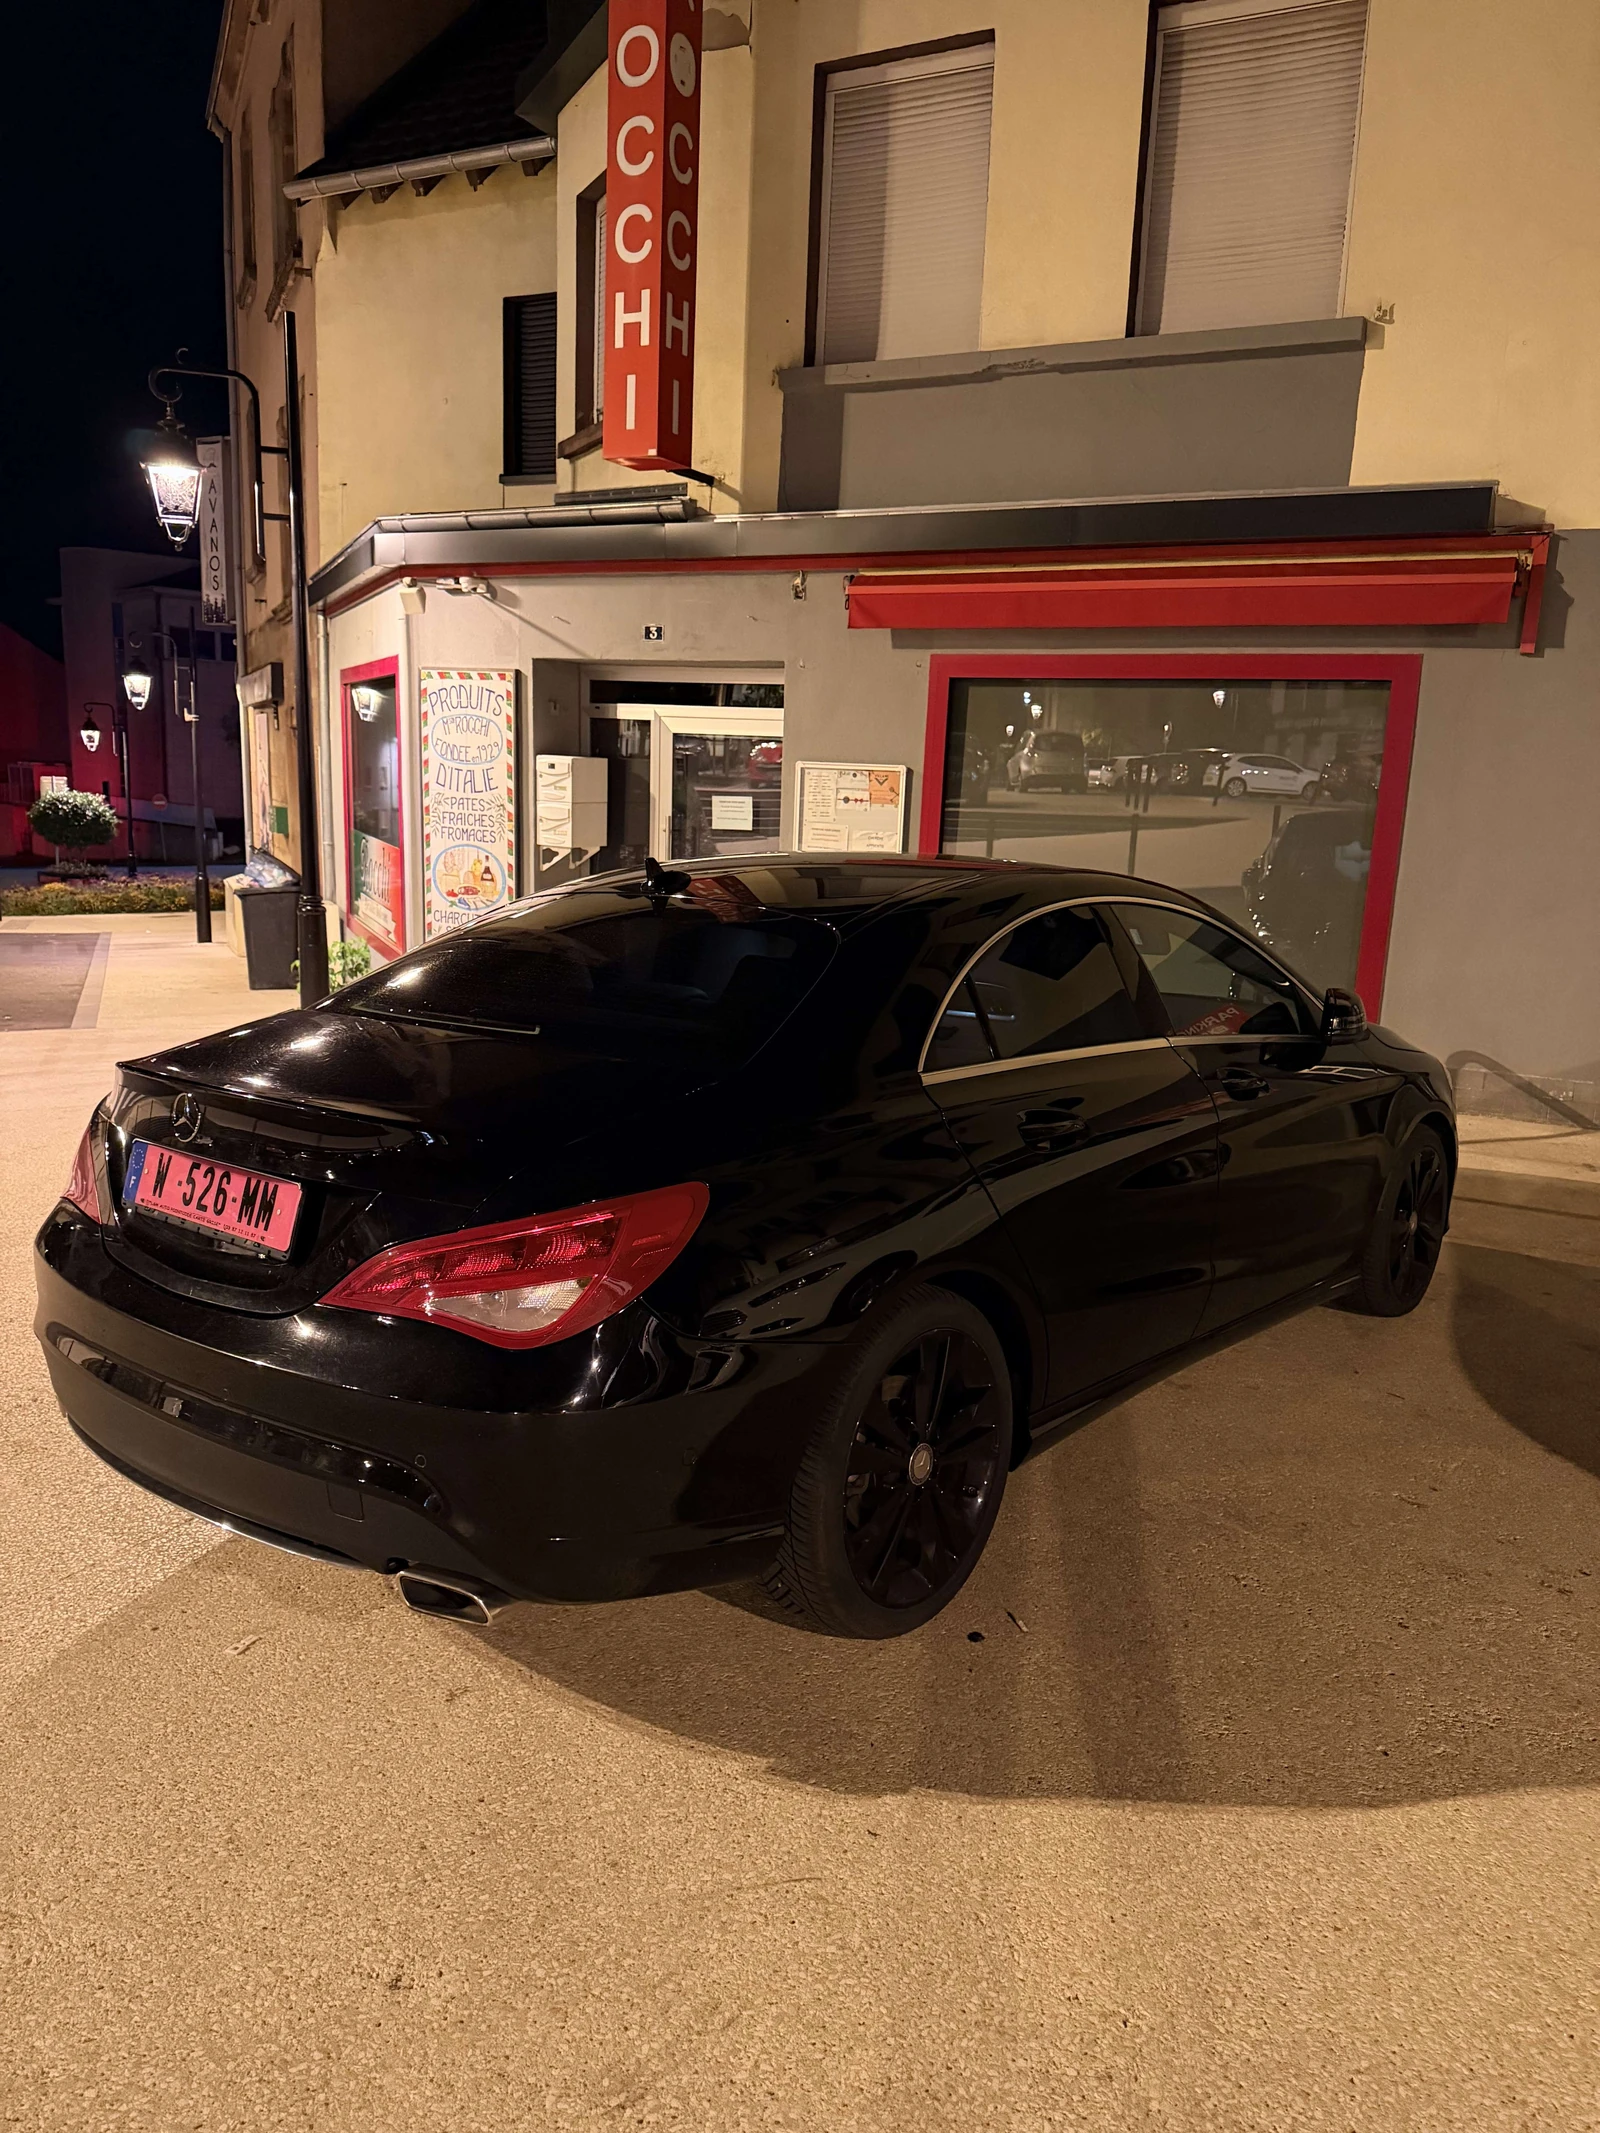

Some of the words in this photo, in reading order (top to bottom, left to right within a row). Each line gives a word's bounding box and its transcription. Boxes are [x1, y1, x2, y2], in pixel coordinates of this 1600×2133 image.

[614, 24, 660, 430] OCCHI
[665, 0, 696, 435] OCCHI
[208, 478, 221, 591] AVANOS
[649, 626, 658, 639] 3
[428, 684, 505, 716] PRODUITS
[455, 716, 491, 737] ROCCHI
[434, 738, 471, 762] FONDEE
[477, 742, 500, 762] 1929
[436, 763, 498, 793] D'ITALIE
[450, 796, 486, 811] PATES
[442, 812, 495, 828] FRAICHES
[441, 827, 497, 843] FROMAGES
[129, 1175, 137, 1188] F
